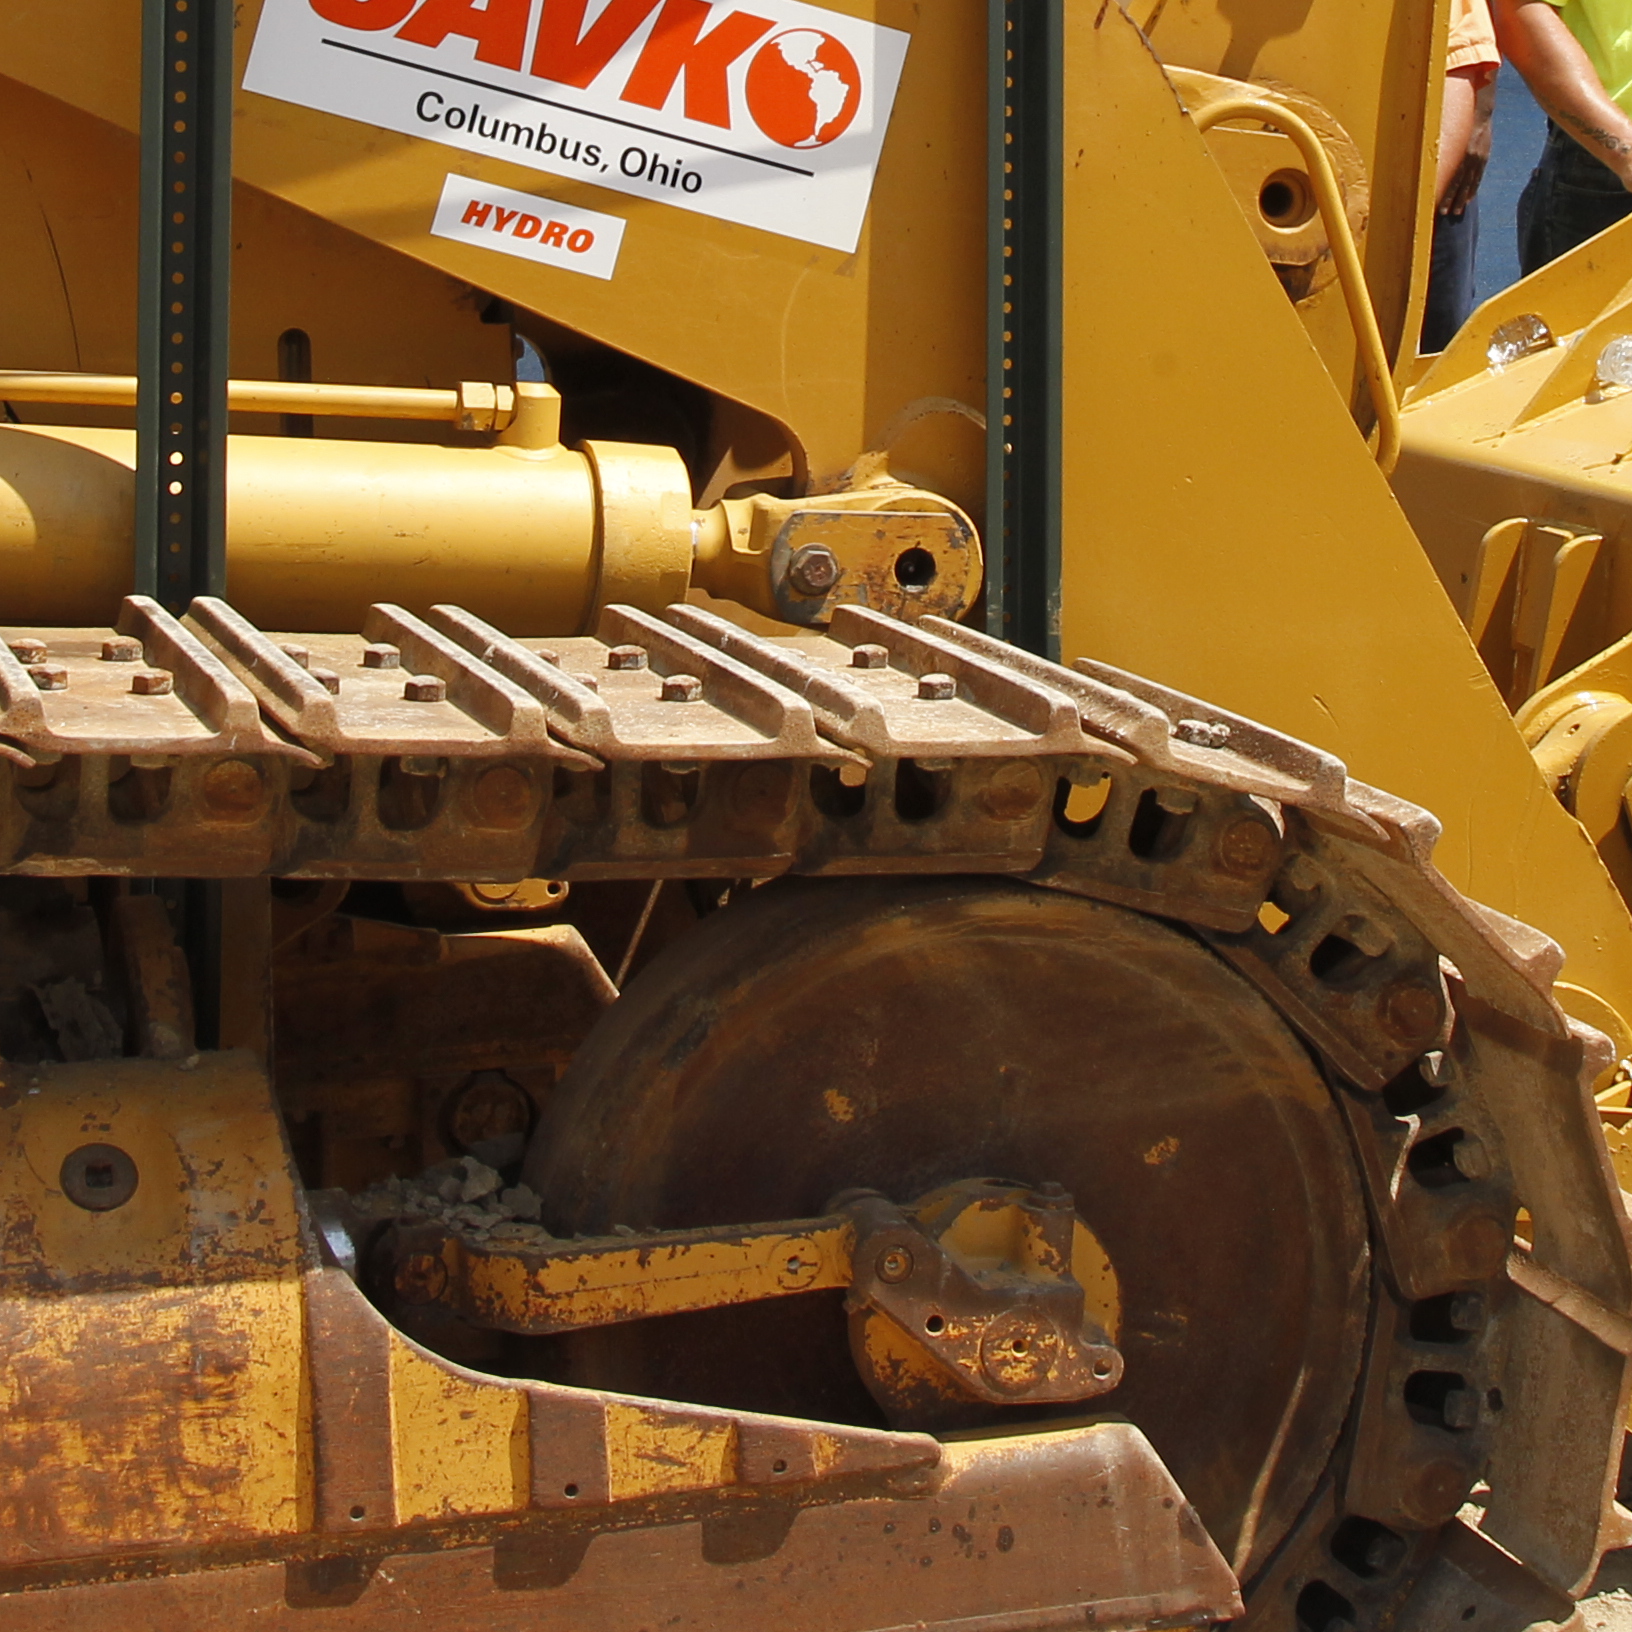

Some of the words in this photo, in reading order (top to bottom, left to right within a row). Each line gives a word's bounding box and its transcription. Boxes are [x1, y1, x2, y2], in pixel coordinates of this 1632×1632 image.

[415, 90, 609, 174] Columbus,
[618, 145, 705, 195] Ohio
[460, 199, 596, 254] HYDRO
